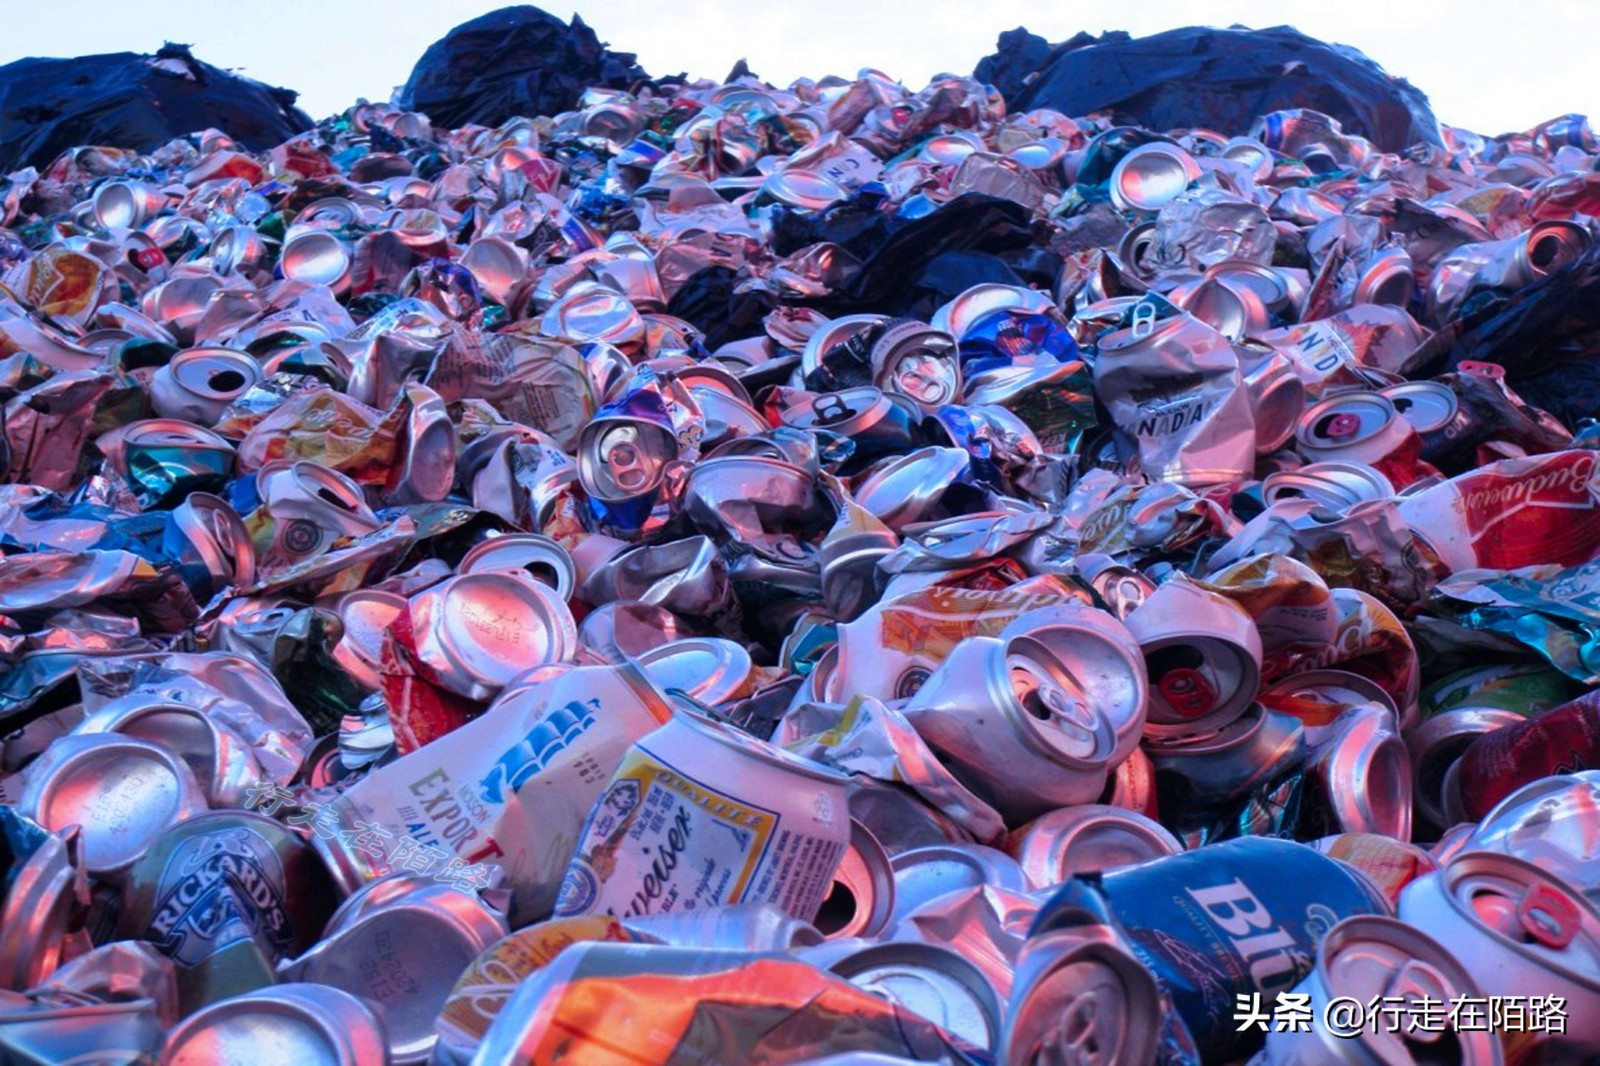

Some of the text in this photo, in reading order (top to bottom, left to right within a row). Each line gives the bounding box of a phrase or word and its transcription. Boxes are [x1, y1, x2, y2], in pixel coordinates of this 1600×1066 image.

[408, 767, 505, 866] EXPORT
[608, 804, 693, 917] weiser
[151, 855, 285, 933] RICKARD'S
